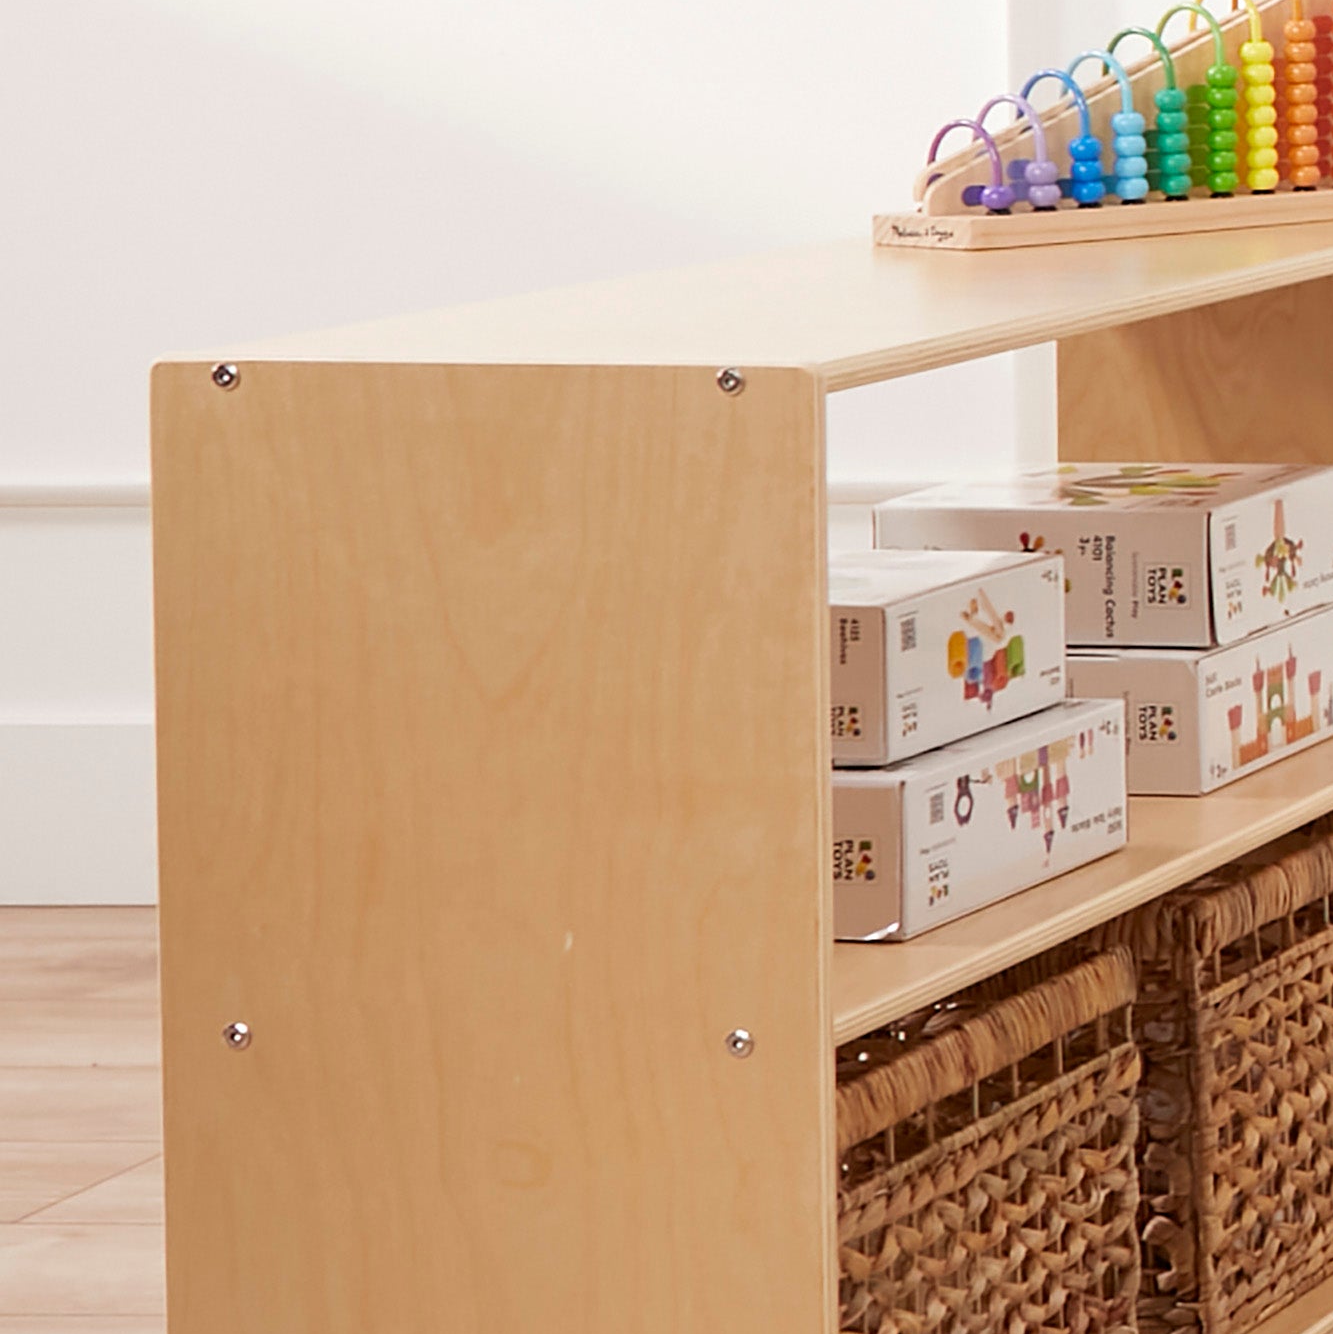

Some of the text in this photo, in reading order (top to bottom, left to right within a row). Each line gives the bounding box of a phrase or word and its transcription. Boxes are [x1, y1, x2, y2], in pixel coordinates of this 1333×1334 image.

[1091, 534, 1103, 561] 4101
[1102, 535, 1117, 638] Balancing Cactus
[1147, 569, 1157, 604] TOYS
[1157, 567, 1168, 604] PLAN
[1138, 706, 1148, 742] TOYS
[1148, 705, 1158, 742] PLAN
[833, 841, 843, 881] TOYS
[843, 839, 854, 881] PLAN
